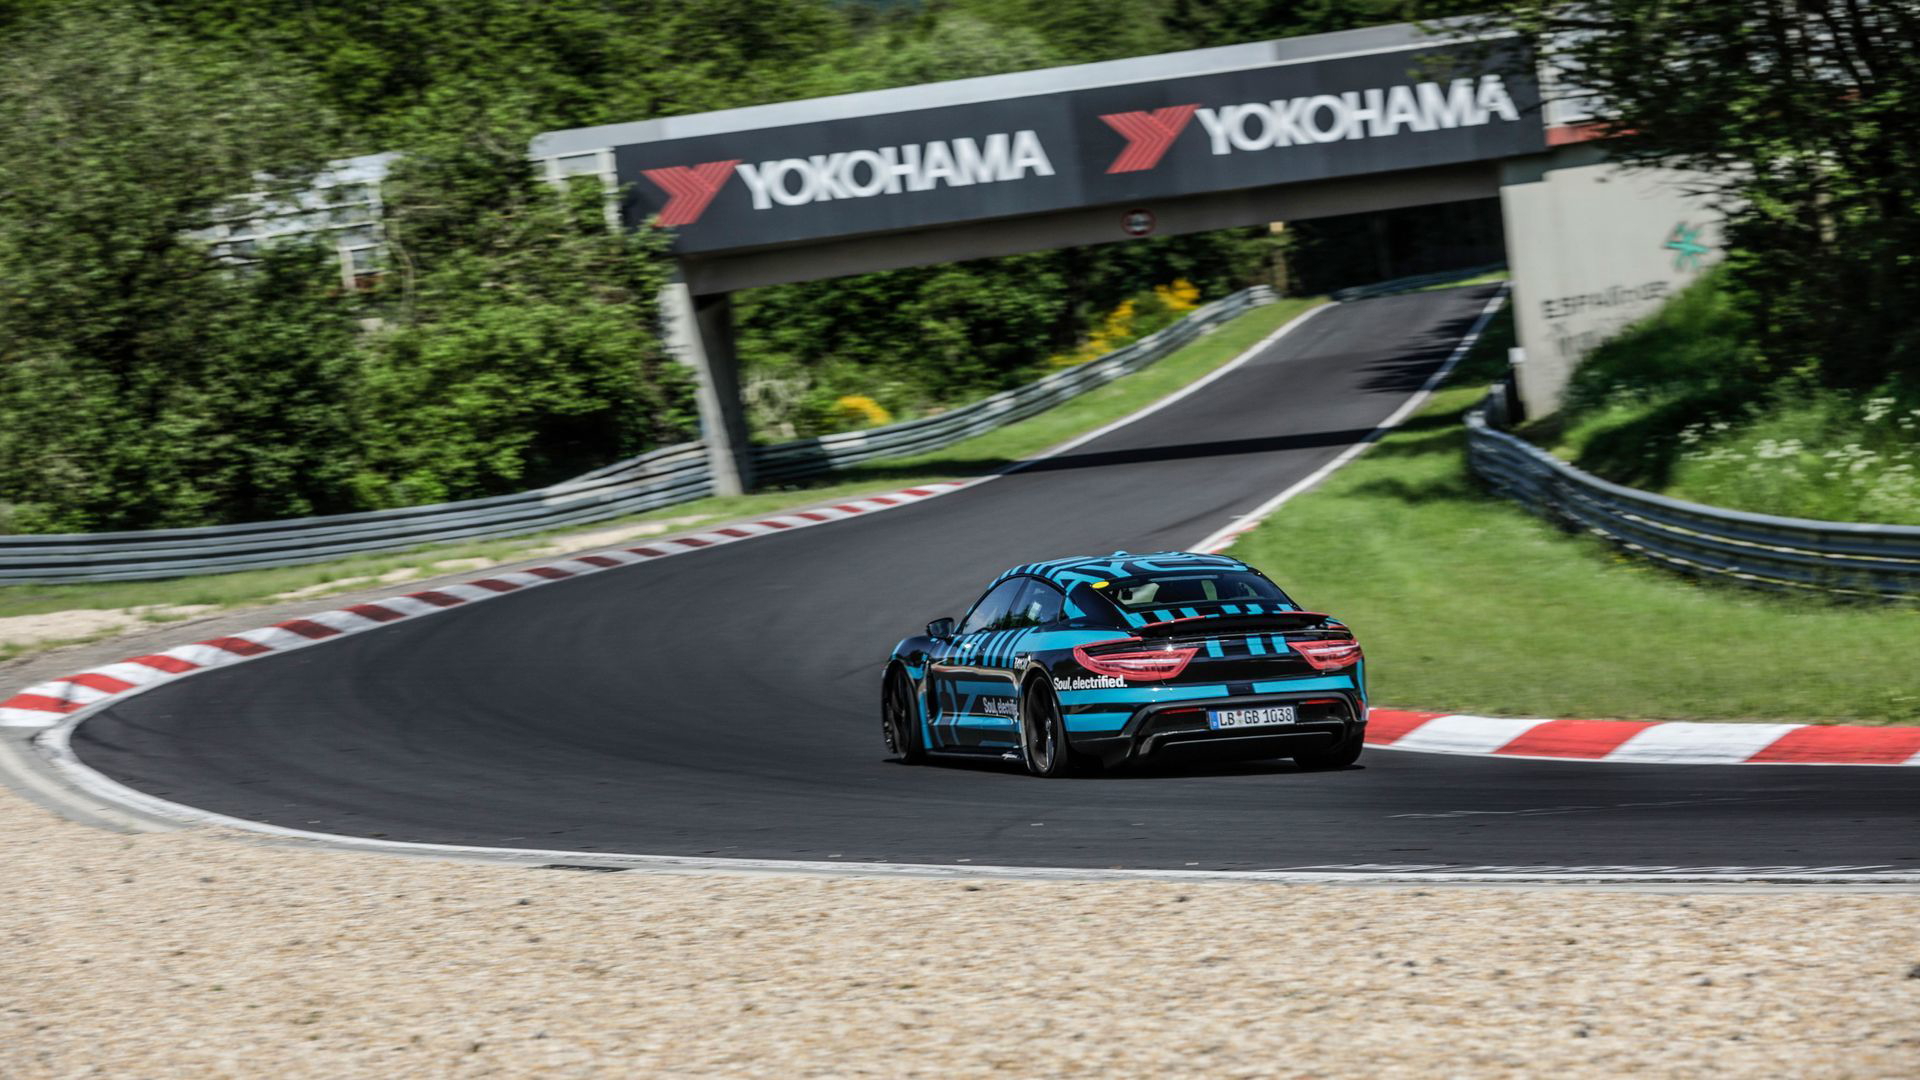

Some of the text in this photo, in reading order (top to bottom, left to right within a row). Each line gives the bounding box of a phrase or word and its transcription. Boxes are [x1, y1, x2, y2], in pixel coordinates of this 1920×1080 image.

[1194, 75, 1520, 155] YOKOHAMA
[735, 130, 1055, 210] YOKOHAMA
[1053, 674, 1128, 690] Soul, electrified.
[1220, 708, 1293, 726] LB GB 1038
